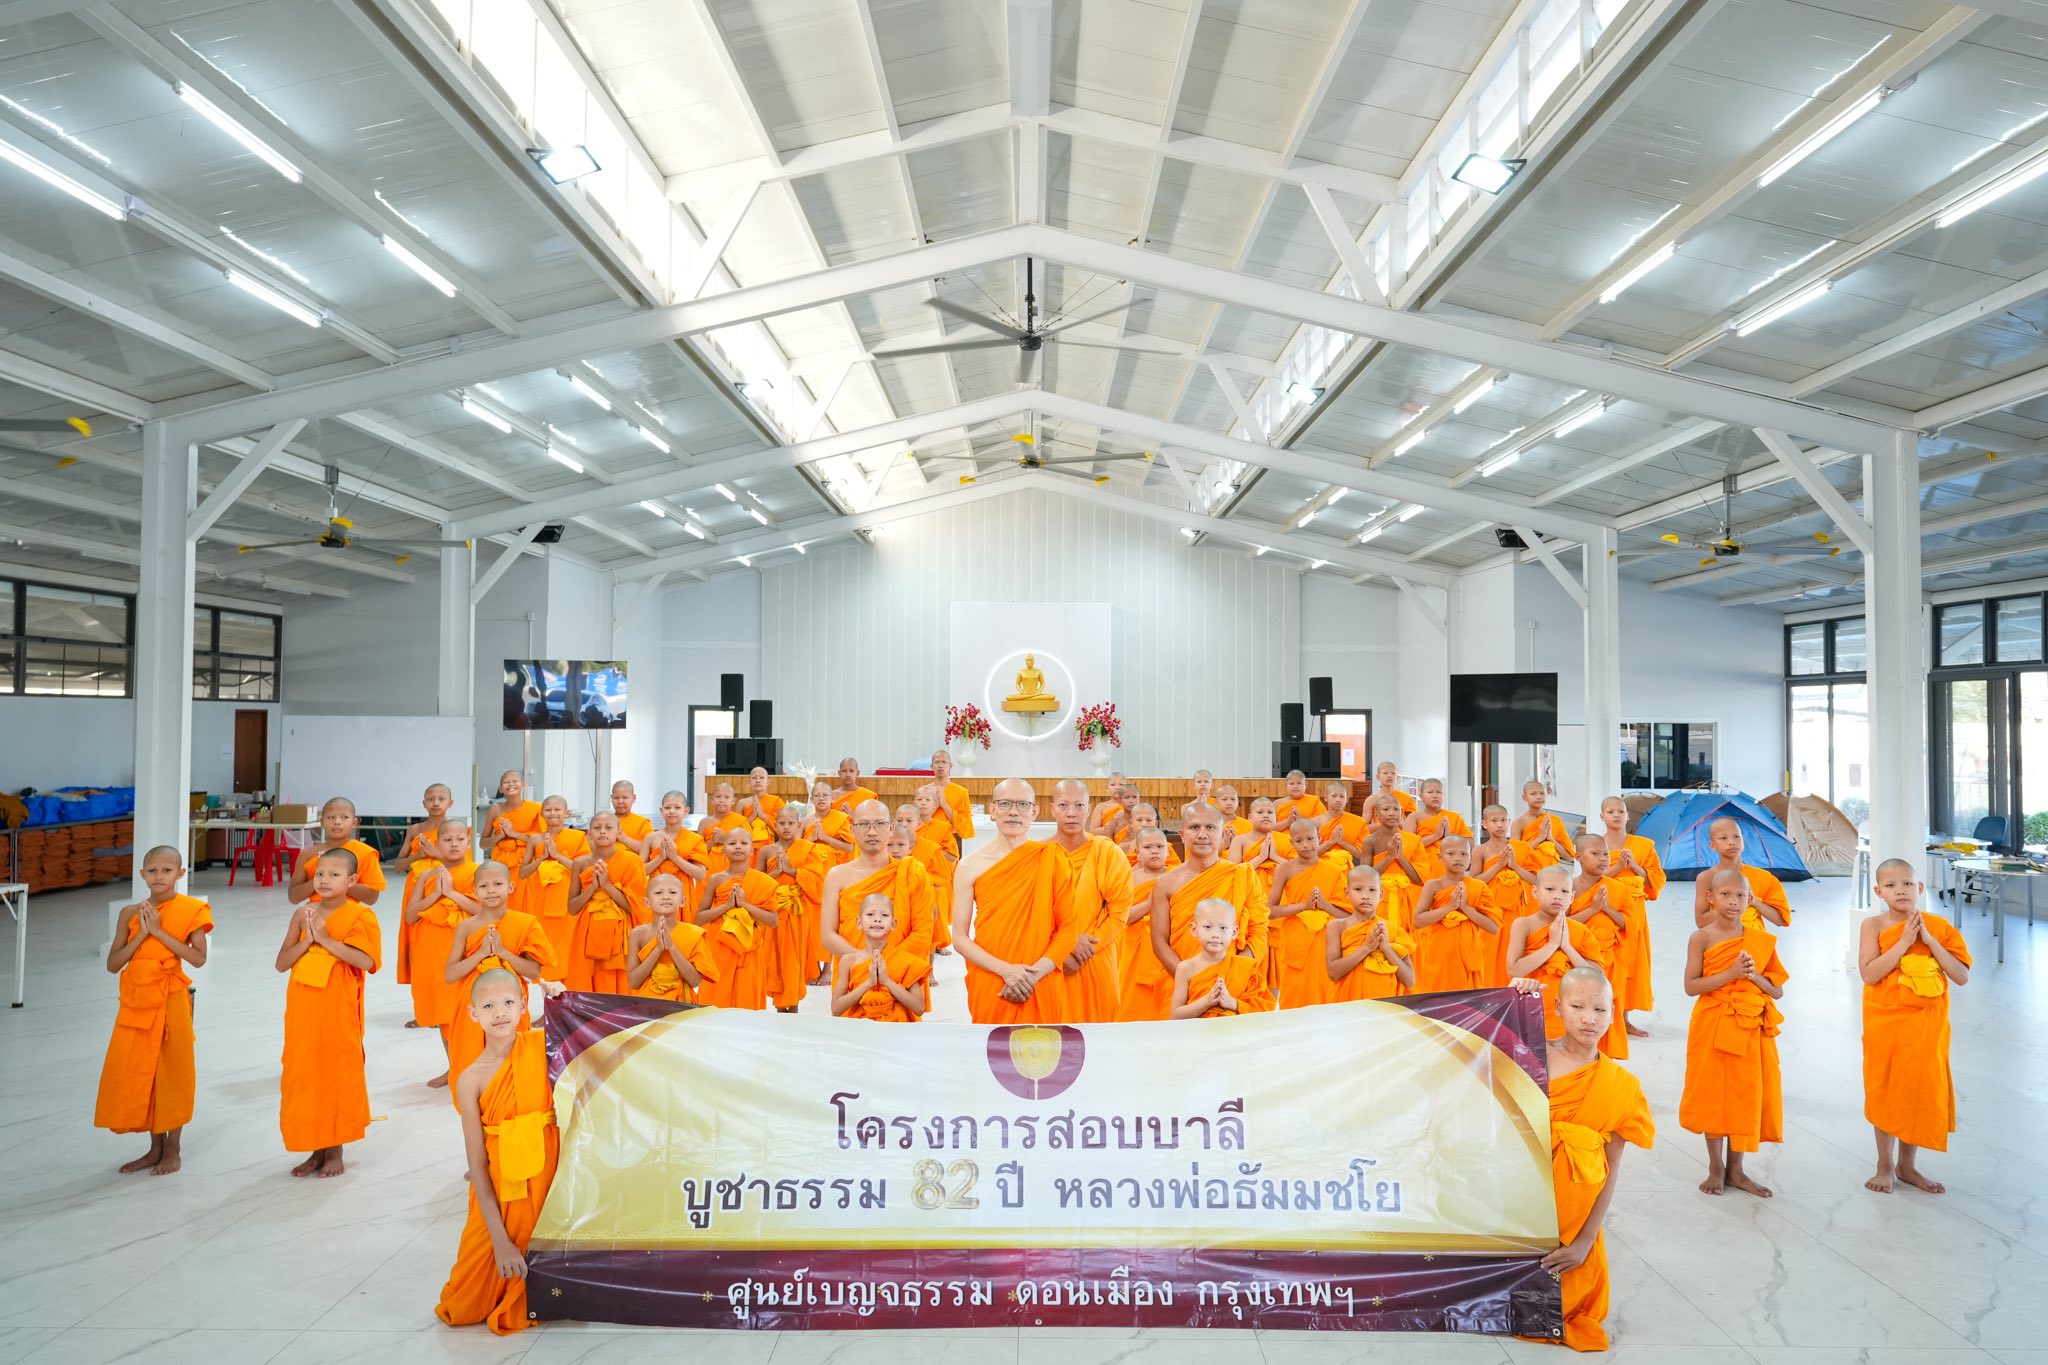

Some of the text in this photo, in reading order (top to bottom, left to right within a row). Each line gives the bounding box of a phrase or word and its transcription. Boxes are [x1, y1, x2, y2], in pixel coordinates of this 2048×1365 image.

[829, 1091, 1246, 1151] โครงการสอบบาลี
[683, 1157, 1402, 1230] บูชาธรรม 82 ปี หลวงพ่อธัมมชโย
[727, 1264, 1355, 1321] ศูนย์เบญจธรรม ดอนเมือง กรุงเทพฯ
